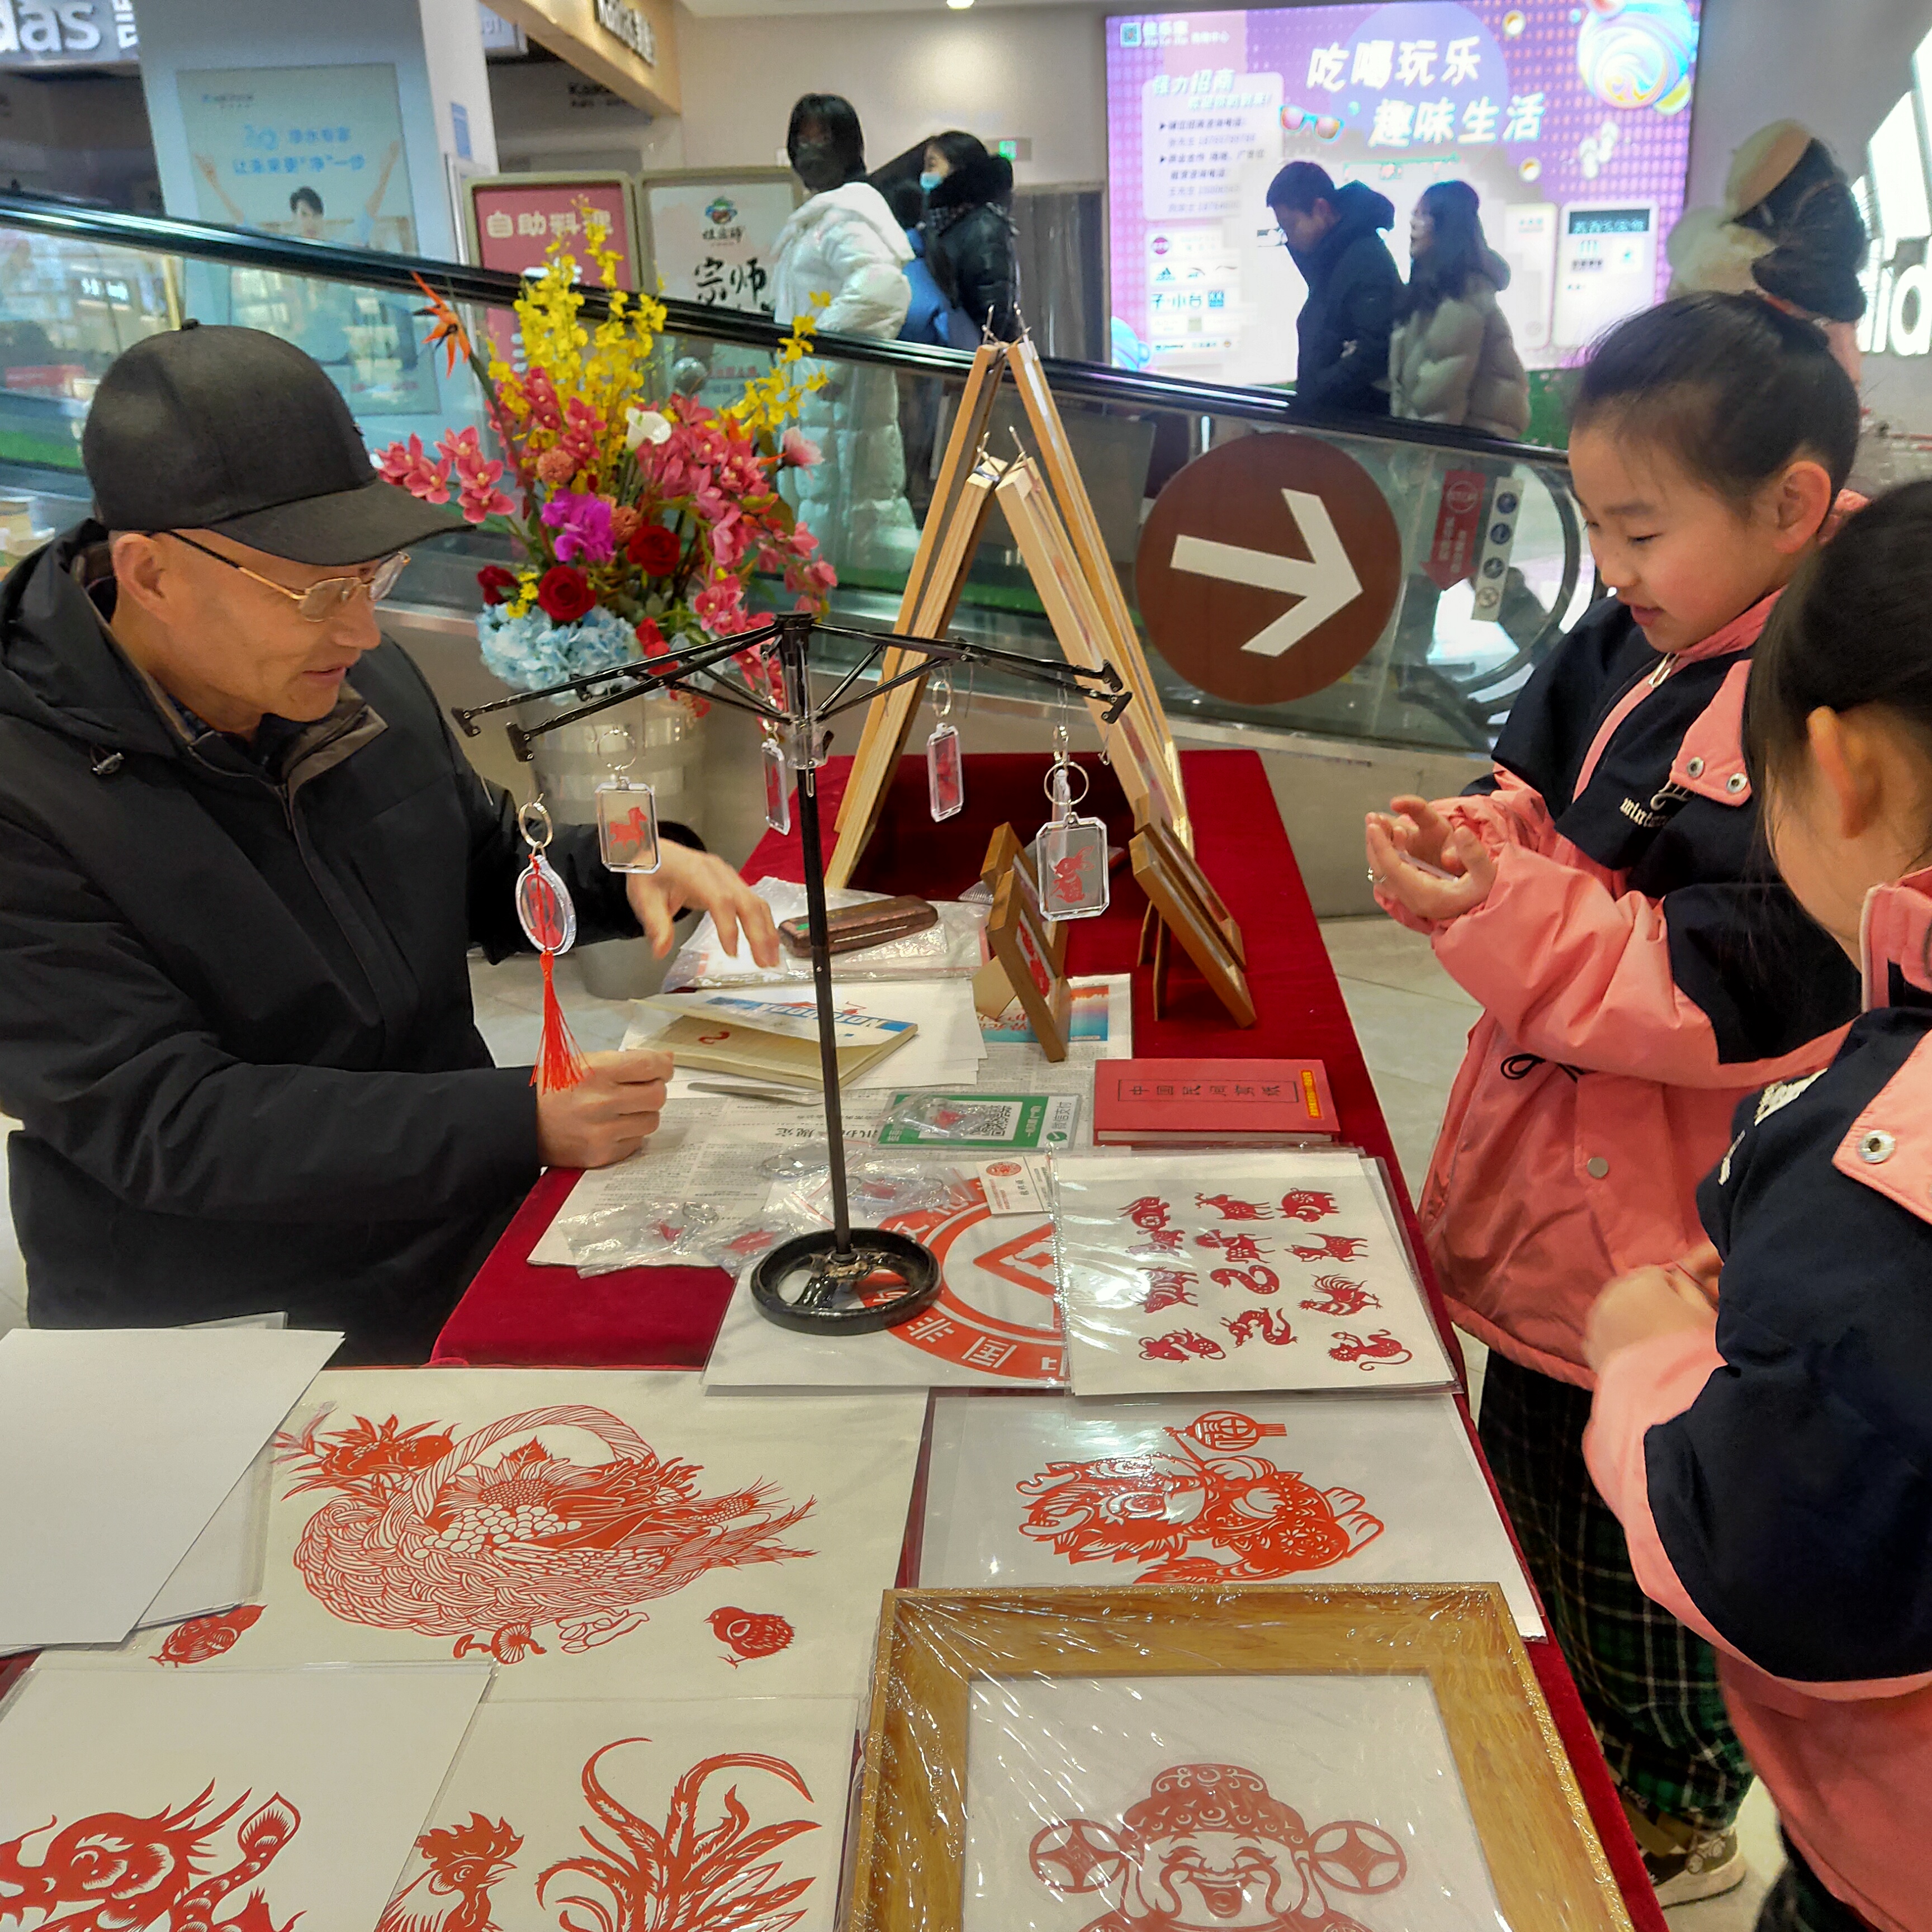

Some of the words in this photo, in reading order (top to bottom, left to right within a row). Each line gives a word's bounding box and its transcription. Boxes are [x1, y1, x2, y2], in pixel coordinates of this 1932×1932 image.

[1306, 36, 1480, 92] 吃喝玩乐
[1368, 92, 1545, 147] 趣味生活
[1053, 1101, 1072, 1129] 微信支付
